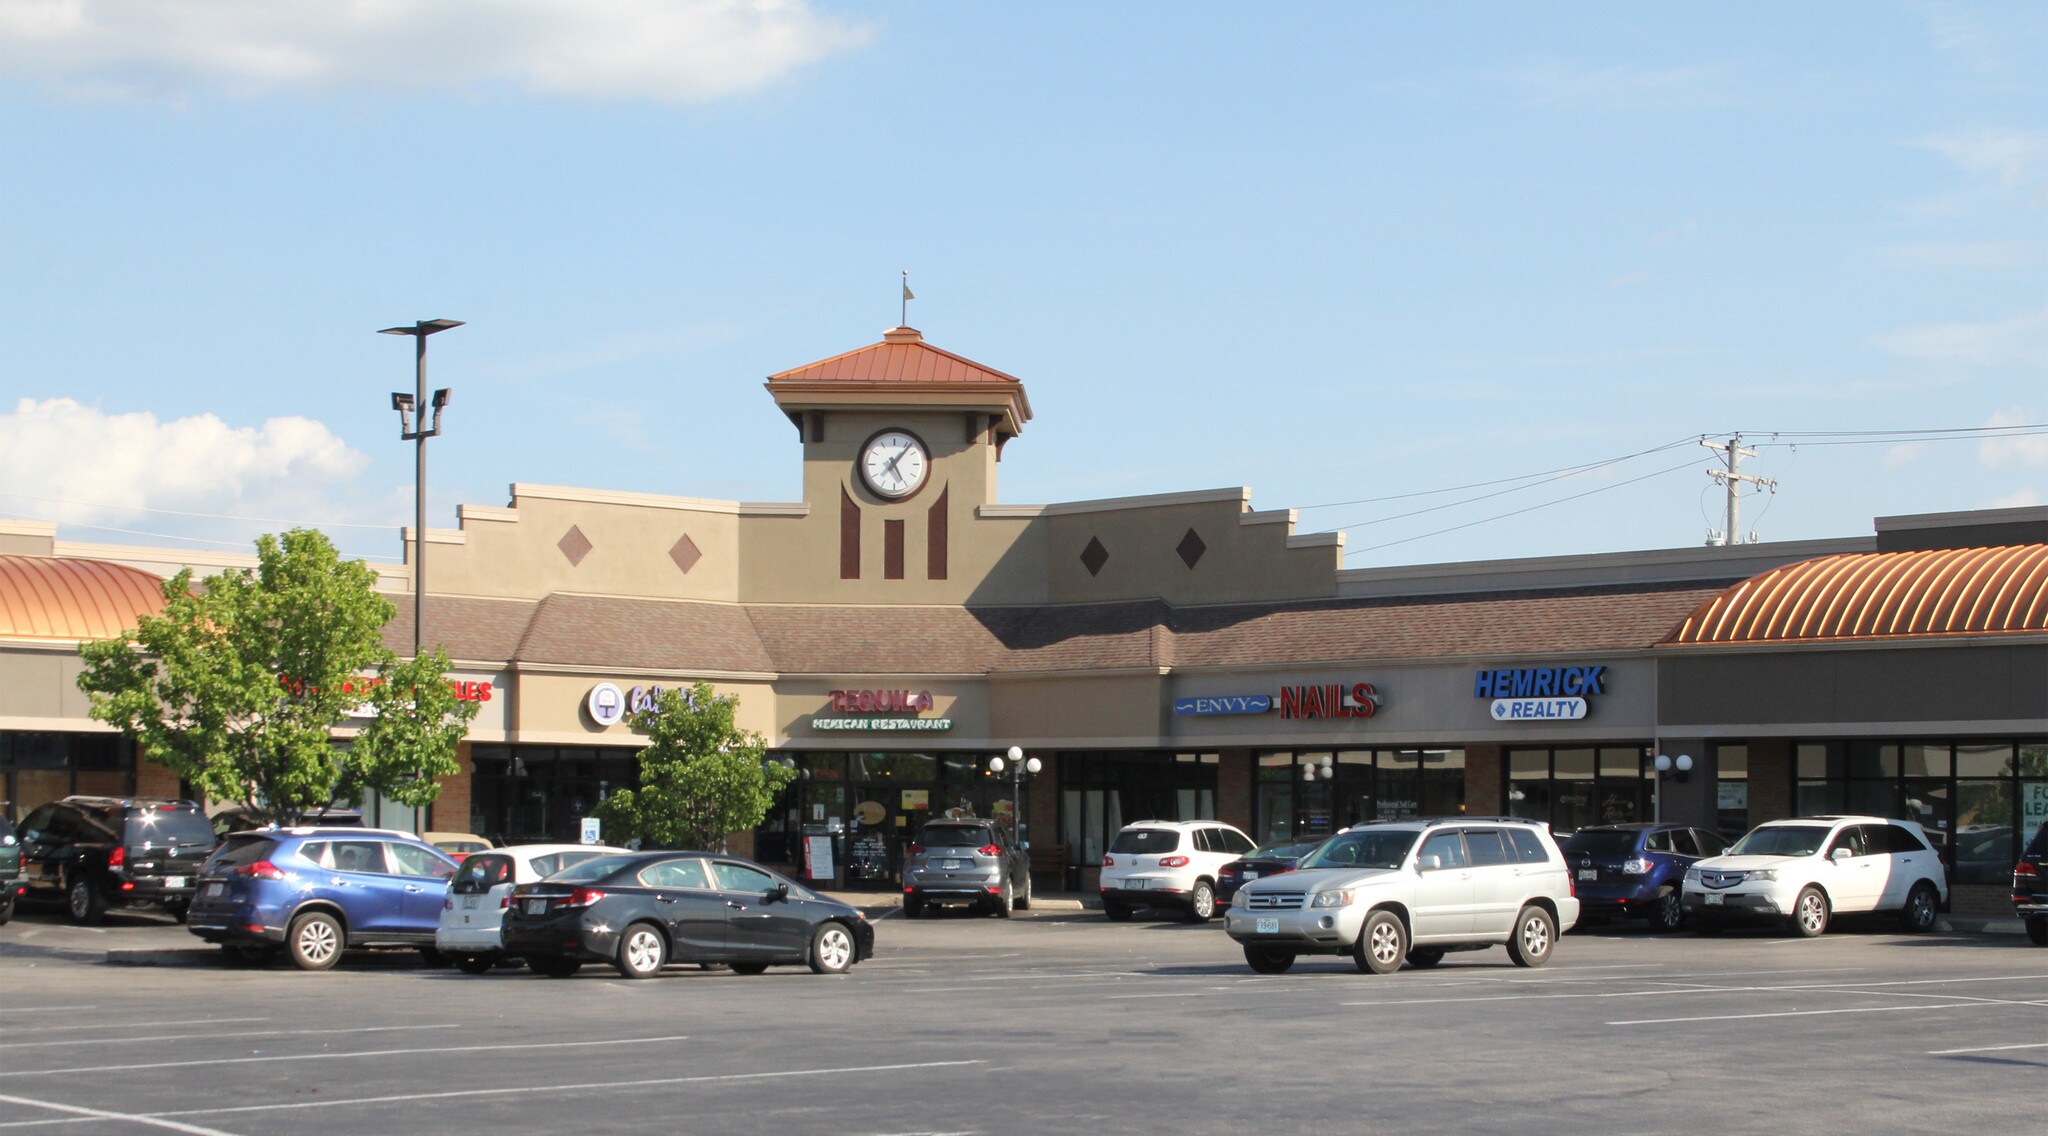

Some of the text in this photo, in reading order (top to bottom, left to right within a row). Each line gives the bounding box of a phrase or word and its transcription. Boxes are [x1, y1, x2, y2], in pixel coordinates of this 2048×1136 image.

[1474, 666, 1603, 698] HEMRICK
[828, 689, 934, 712] TEQUILA
[1196, 682, 1375, 719] ENVY NAILS
[1510, 701, 1579, 718] REALTY
[812, 718, 951, 730] MEXICAN RESTAURANT
